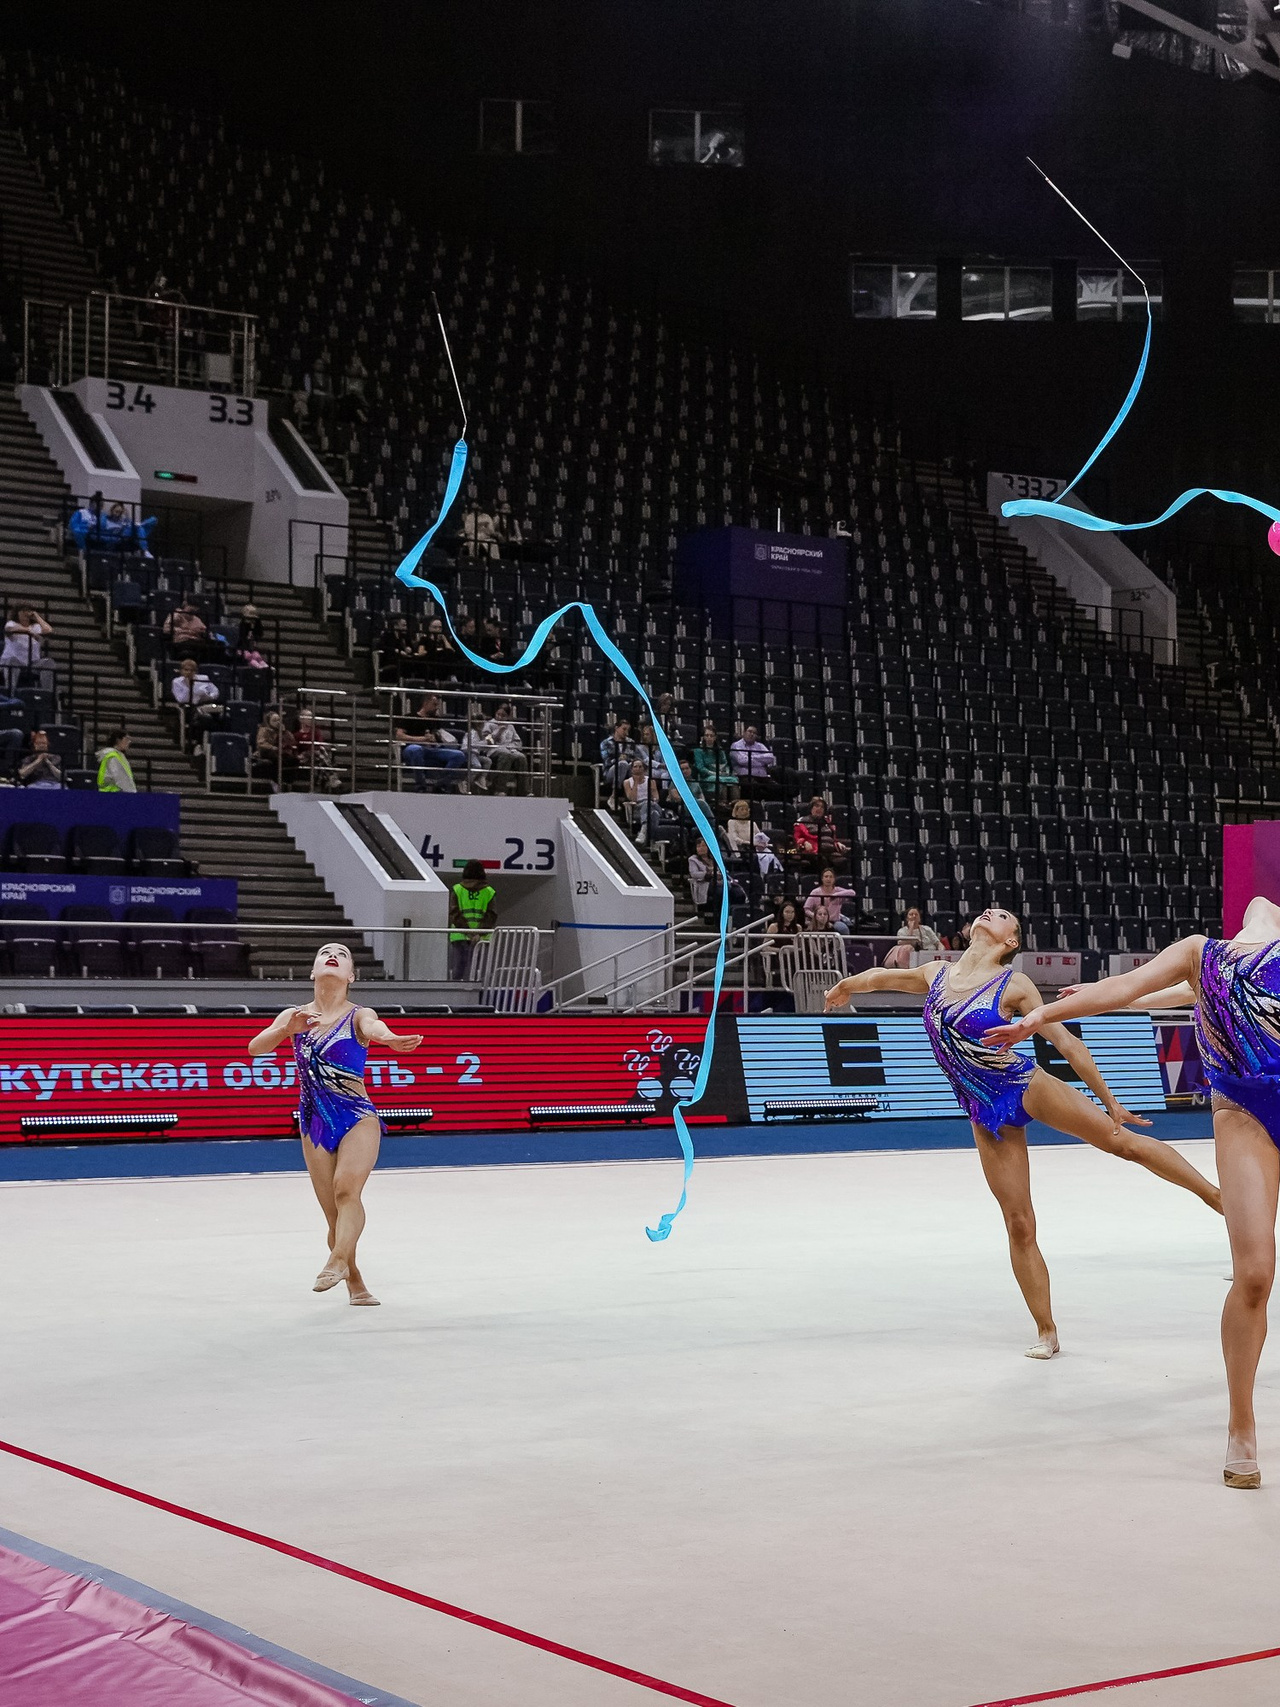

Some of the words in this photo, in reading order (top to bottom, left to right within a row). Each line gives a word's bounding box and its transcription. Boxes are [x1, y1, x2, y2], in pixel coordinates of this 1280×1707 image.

[106, 381, 156, 414] 3.4
[209, 394, 253, 426] 3.3
[504, 837, 555, 871] 2.3
[455, 1051, 484, 1086] 2
[821, 1022, 887, 1086] Е
